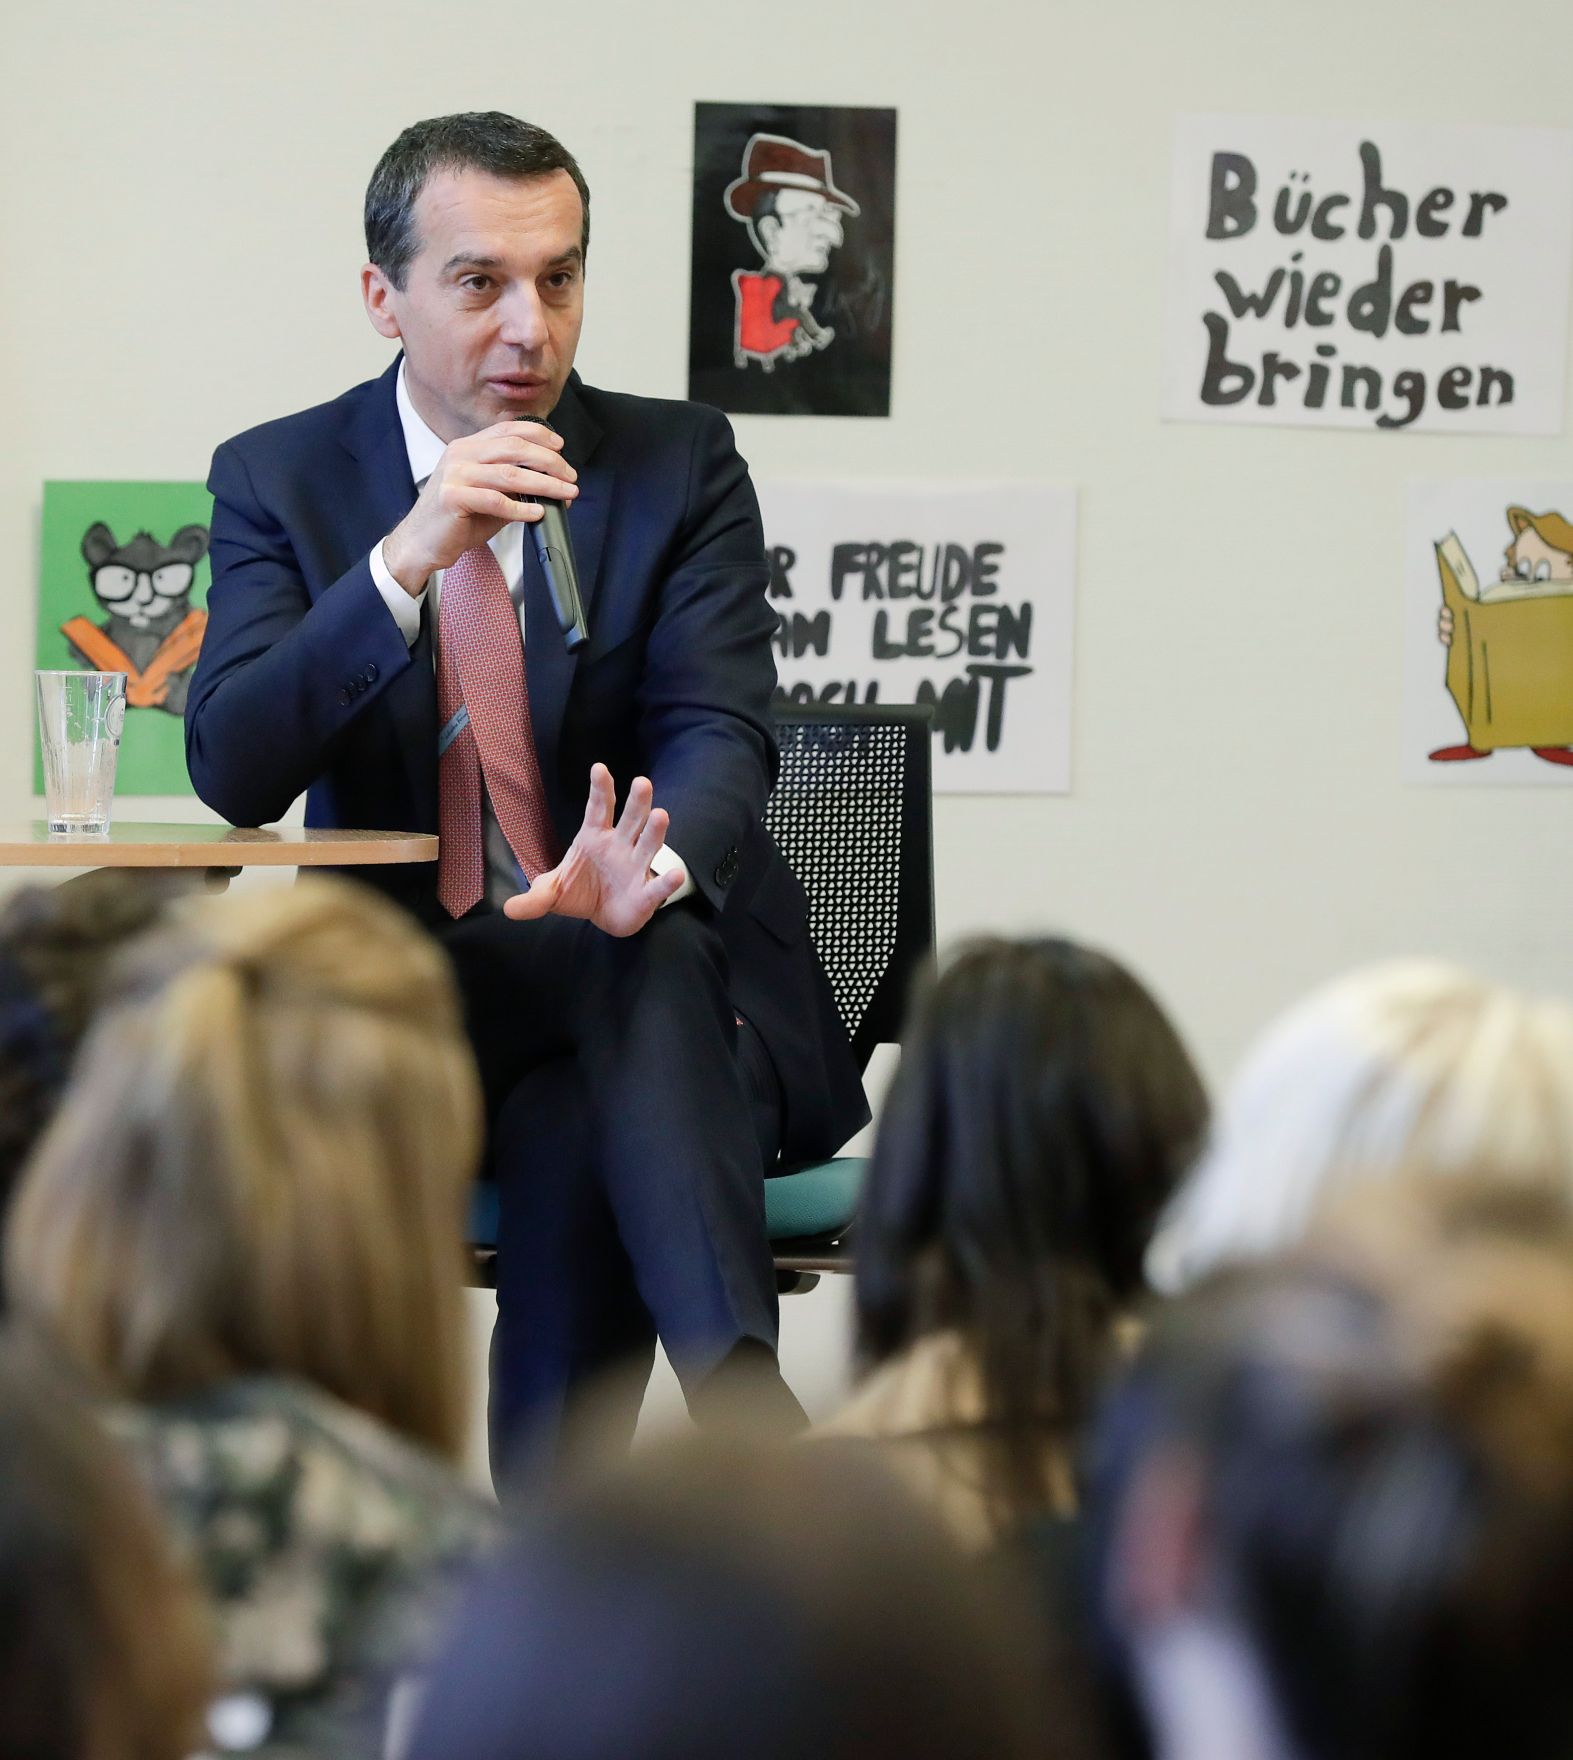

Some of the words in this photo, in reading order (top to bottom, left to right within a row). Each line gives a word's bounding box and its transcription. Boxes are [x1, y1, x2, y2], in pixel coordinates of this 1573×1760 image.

[1205, 140, 1509, 242] Bücher
[1213, 243, 1483, 339] wieder
[1199, 311, 1515, 430] bringen
[764, 545, 797, 600] R
[830, 540, 1006, 603] FREUDE
[871, 601, 1034, 660] LESEN
